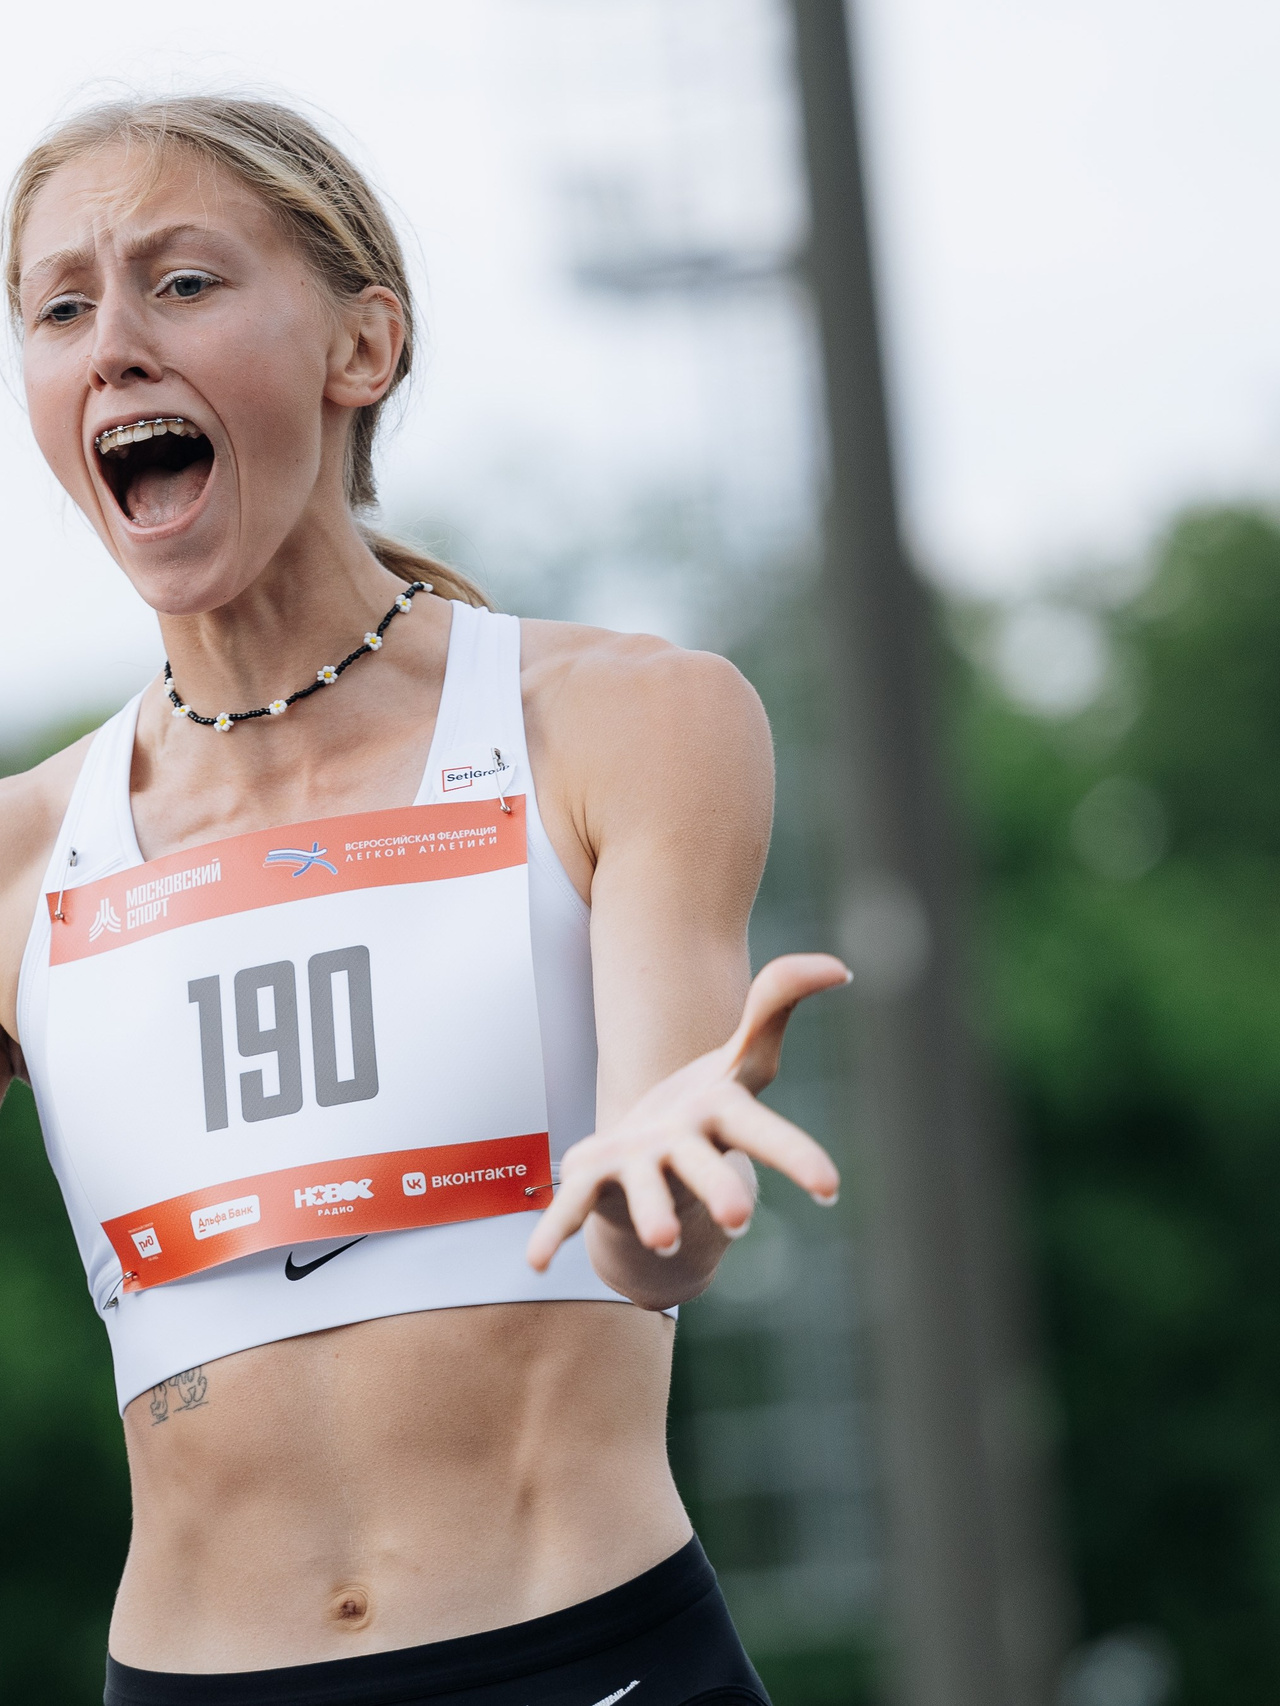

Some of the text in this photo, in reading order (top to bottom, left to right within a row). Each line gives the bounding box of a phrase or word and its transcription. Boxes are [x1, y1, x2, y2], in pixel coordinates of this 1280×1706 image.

[345, 826, 497, 852] ВСЕРОССИЙСКАЯ ФЕДЕРАЦИЯ
[345, 836, 498, 863] ЛЕГКОЙ АТЛЕТИКИ
[125, 858, 222, 909] МОСКОВСКИЙ
[126, 897, 170, 930] СПОРТ
[187, 944, 380, 1133] 190
[198, 1205, 254, 1229] Альфа Банк
[317, 1205, 354, 1216] РАДИО
